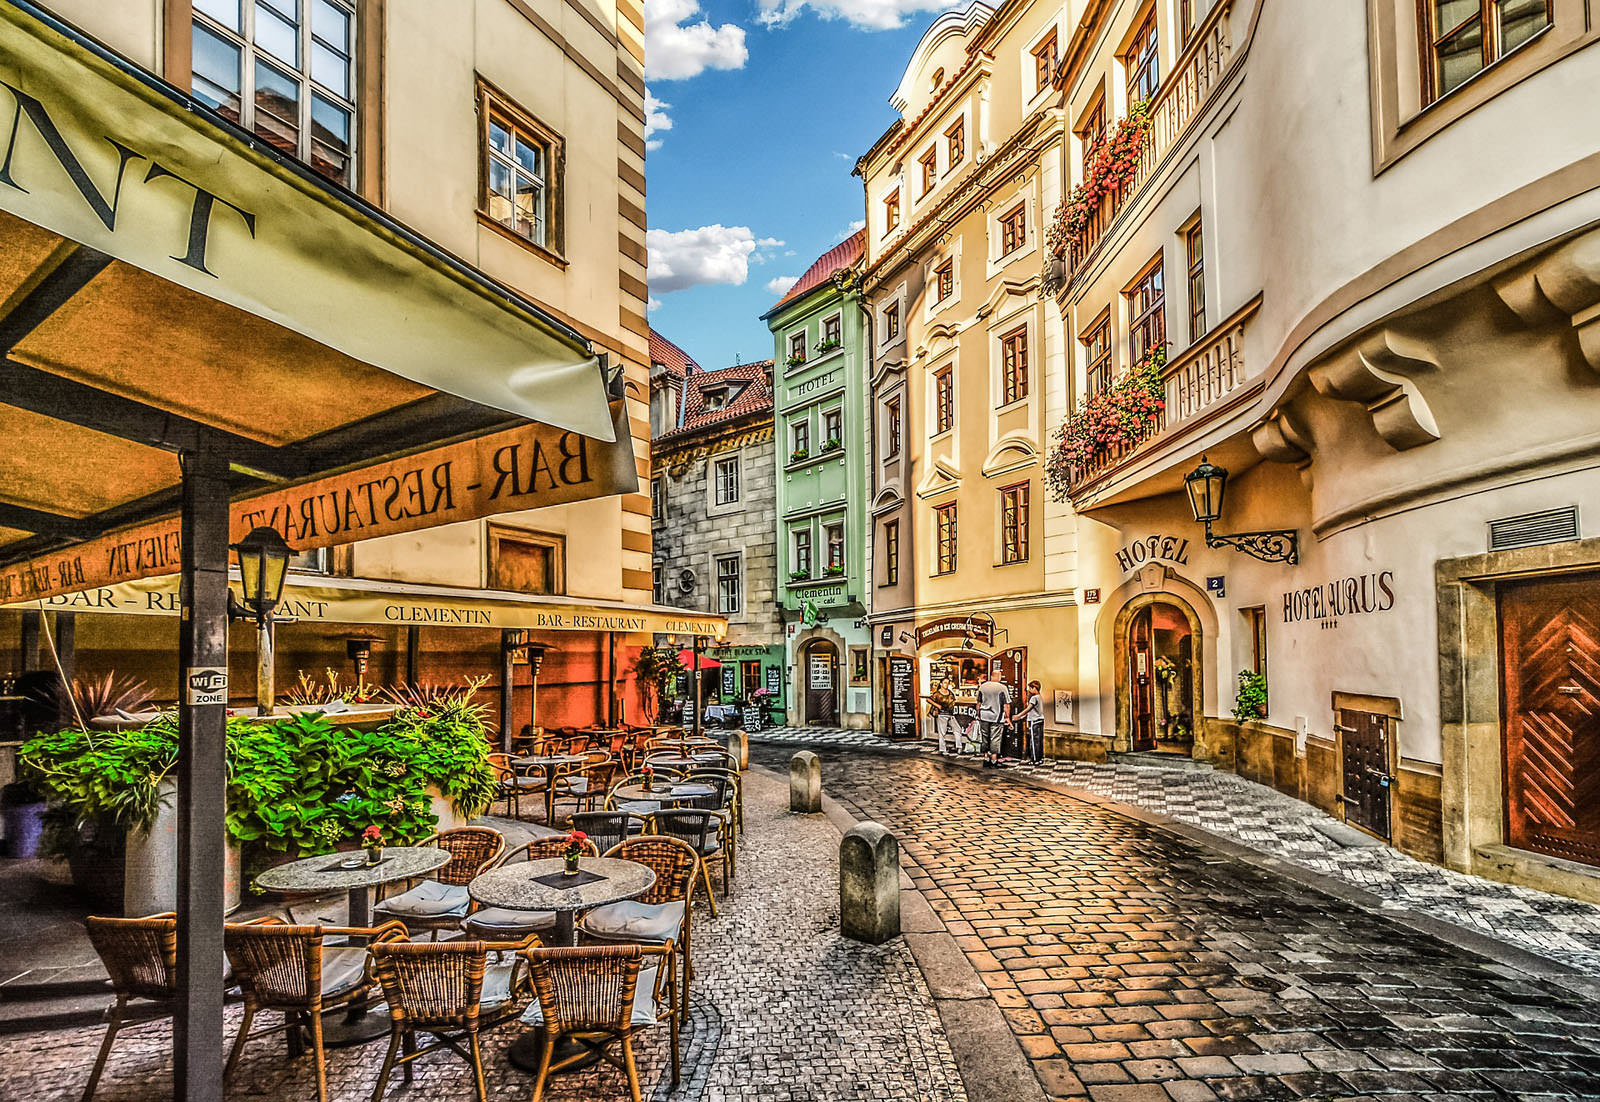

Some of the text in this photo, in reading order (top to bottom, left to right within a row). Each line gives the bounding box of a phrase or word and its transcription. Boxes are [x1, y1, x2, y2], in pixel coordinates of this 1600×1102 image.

[798, 372, 835, 396] HOTEL
[1115, 534, 1190, 573] HOTEL
[1211, 579, 1219, 588] 2
[795, 586, 842, 600] Clementin
[1283, 571, 1395, 623] HOTEL AURUS
[384, 605, 492, 625] CLEMENTIN
[537, 613, 563, 627] BAR
[573, 615, 647, 630] RESTAURANT
[665, 620, 718, 634] CLEMENTIN
[196, 694, 223, 703] ZONE
